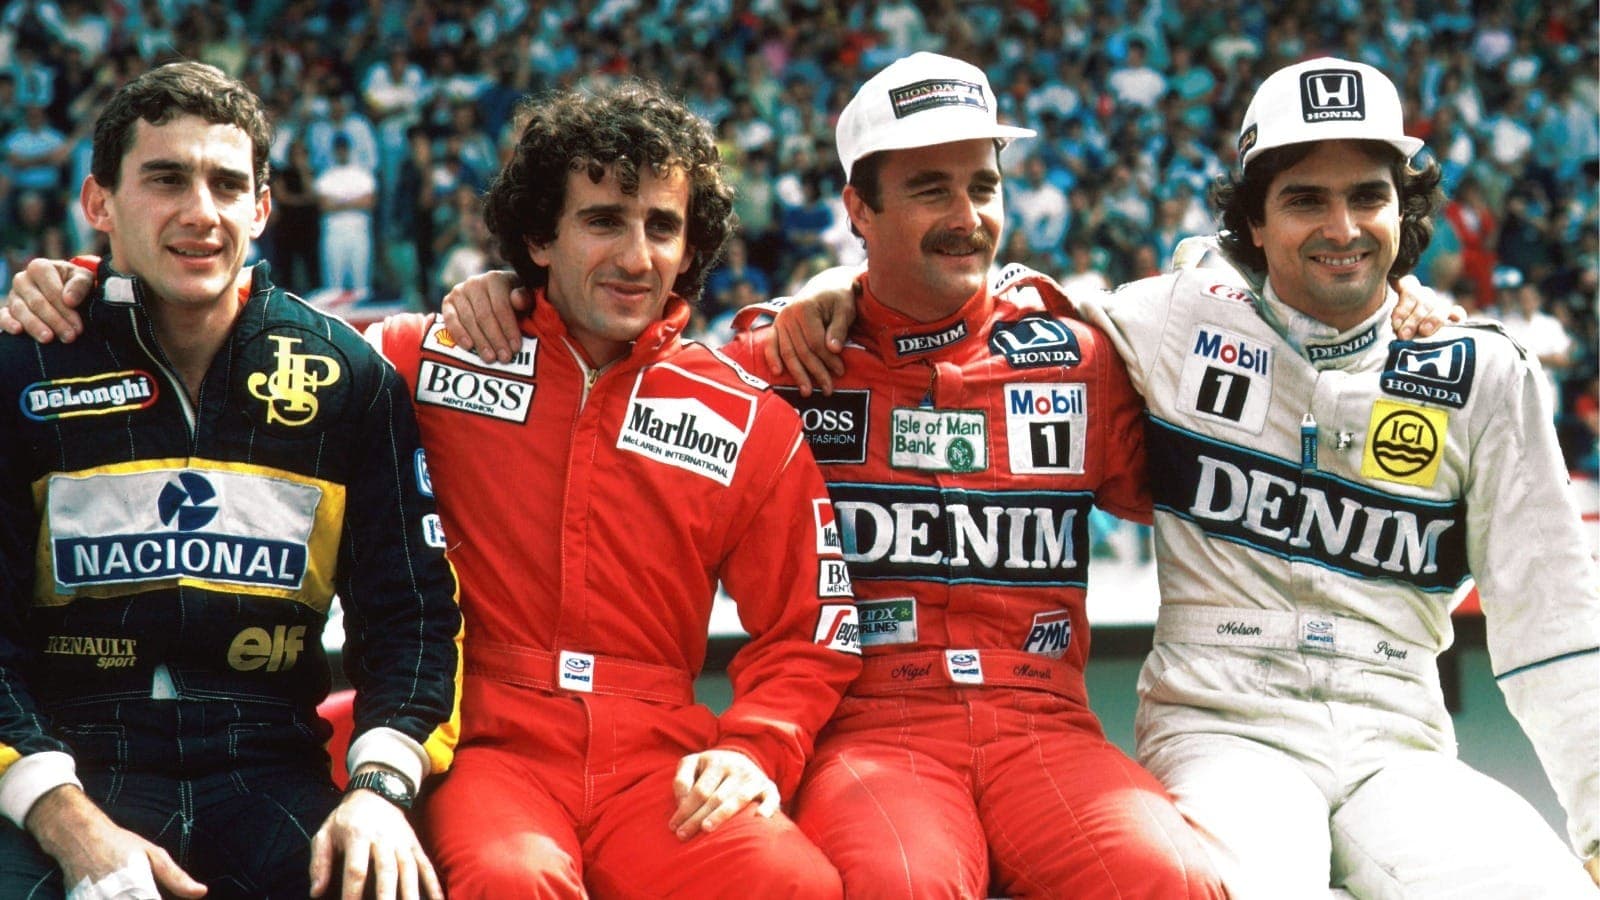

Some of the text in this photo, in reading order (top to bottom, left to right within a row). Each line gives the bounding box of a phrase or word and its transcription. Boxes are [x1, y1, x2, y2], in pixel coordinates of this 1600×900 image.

[1306, 111, 1363, 121] HONDA
[898, 324, 967, 354] DENIM
[1310, 331, 1376, 360] DENIM
[1010, 350, 1080, 364] HONDA
[1193, 331, 1268, 377] Mobil
[424, 363, 524, 411] BOSS
[1212, 373, 1234, 415] 1
[1386, 378, 1463, 404] HONDA
[1010, 389, 1083, 416] Mobil
[627, 402, 738, 464] Marlboro
[795, 408, 854, 431] OSS
[895, 414, 982, 436] Isle of Man
[1390, 420, 1424, 446] ICI
[812, 434, 856, 444] FASHION
[895, 434, 936, 456] Bank
[1040, 425, 1057, 465] 1
[623, 434, 729, 479] McLAREN INTERNATIONAL
[1189, 455, 1455, 575] DENIM
[834, 501, 1078, 568] DENIM
[73, 539, 296, 580] NACIONAL
[1022, 621, 1070, 652] PMG
[1216, 623, 1263, 636] Nelson
[44, 636, 137, 656] RENAULT
[226, 624, 307, 673] elf
[1374, 640, 1409, 660] Piquet
[96, 656, 137, 670] sport
[891, 663, 932, 681] Nigel
